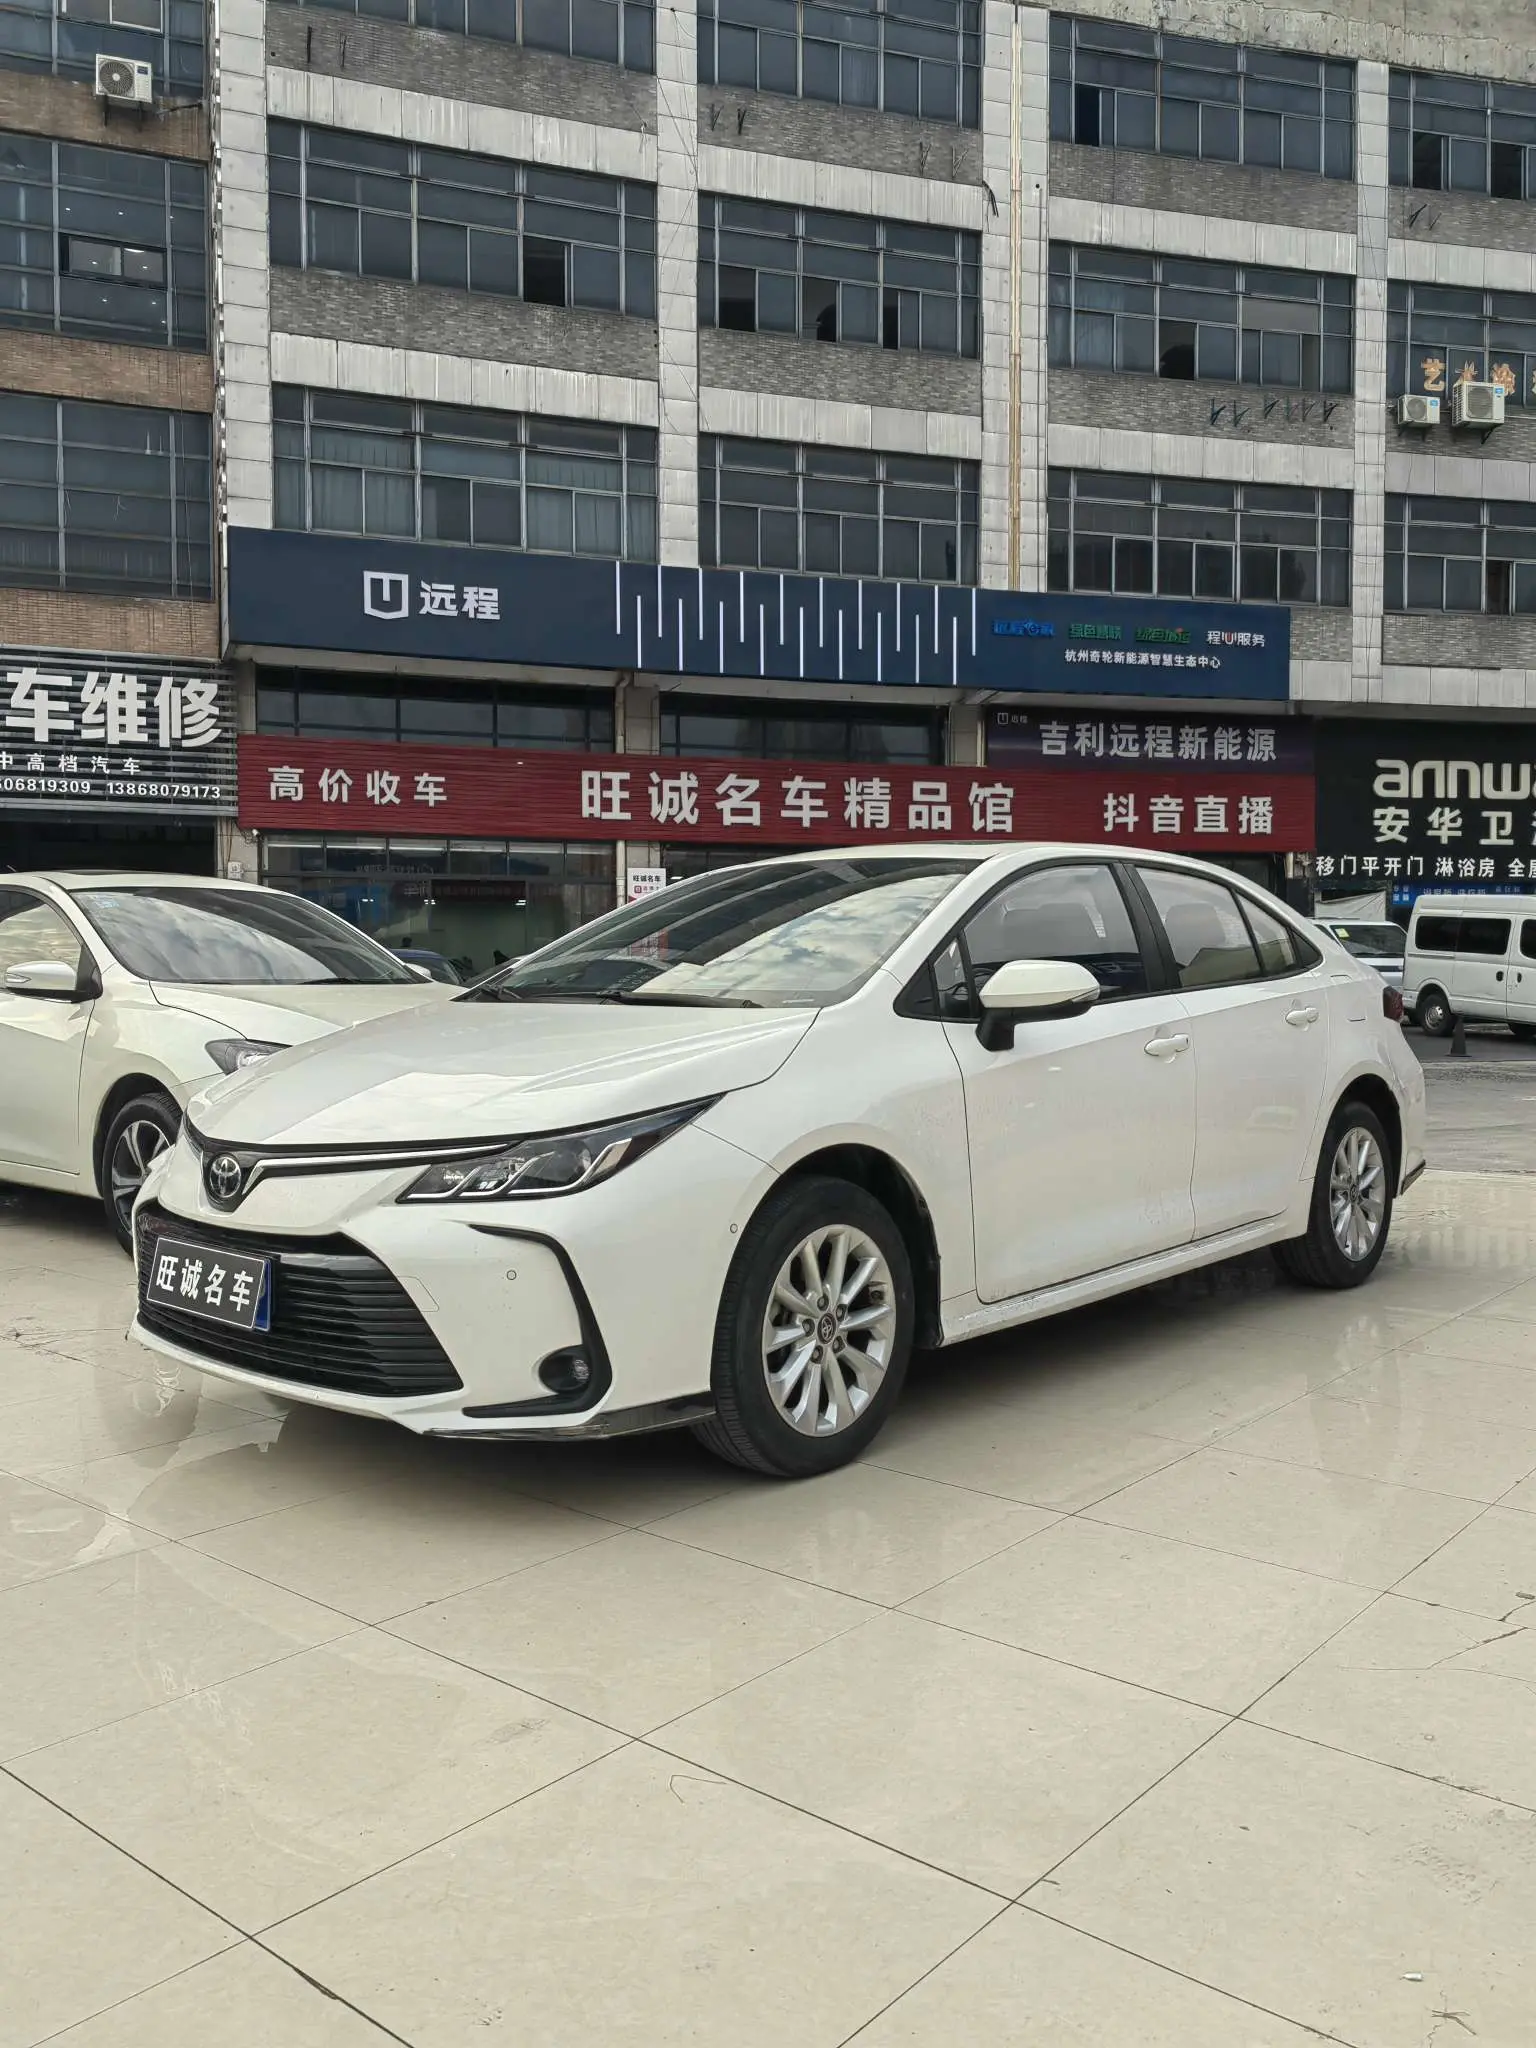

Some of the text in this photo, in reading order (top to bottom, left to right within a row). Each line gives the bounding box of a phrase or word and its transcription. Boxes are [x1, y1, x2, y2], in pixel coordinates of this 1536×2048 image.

[418, 580, 501, 620] 远程
[6, 667, 222, 747] 车维修
[1039, 721, 1277, 761] 吉利远程新能源
[0, 778, 221, 799] 06819309 13868079173
[267, 765, 447, 808] 高价收车
[1373, 759, 1536, 800] annw
[581, 770, 1014, 833] 旺诚名车精品馆
[1103, 792, 1273, 834] 抖音直播
[1373, 806, 1536, 846] 安华卫
[1315, 855, 1424, 877] 移门平开门
[1435, 856, 1495, 878] 淋浴房
[156, 1254, 254, 1312] 旺诚名车
